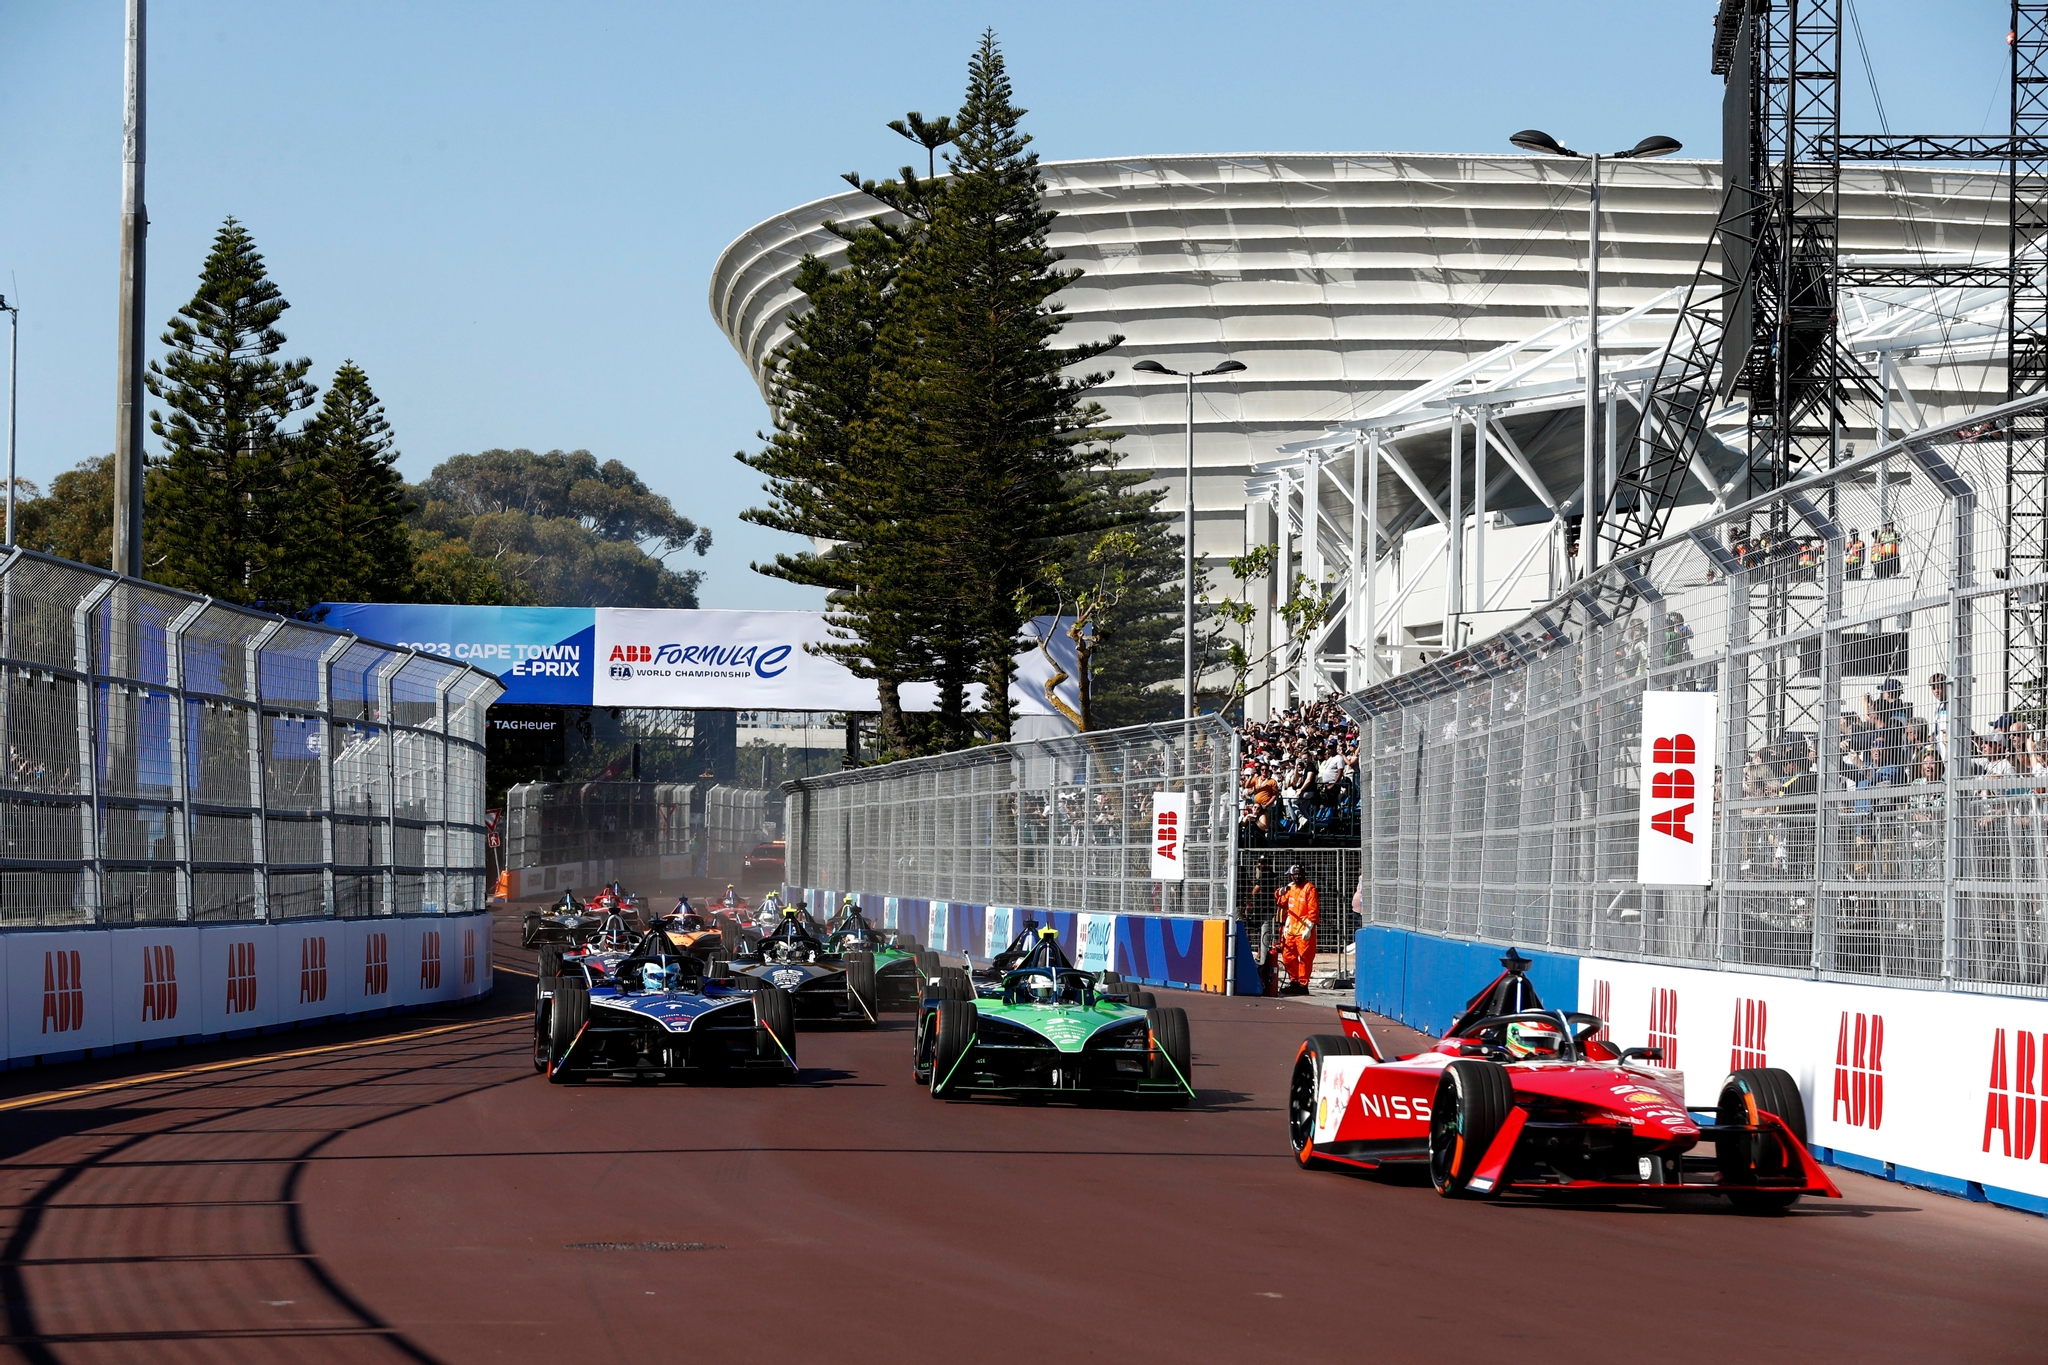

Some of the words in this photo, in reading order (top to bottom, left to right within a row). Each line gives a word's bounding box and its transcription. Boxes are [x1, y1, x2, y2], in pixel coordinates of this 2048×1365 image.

[455, 643, 511, 659] CAPE
[515, 645, 580, 661] TOWN
[512, 661, 580, 677] E-PRIX
[609, 645, 652, 662] ABB
[654, 644, 758, 667] FORMULA
[636, 669, 671, 677] WORLD
[675, 669, 751, 678] CHAMPIONSHIP
[1652, 733, 1695, 844] ABB
[1157, 811, 1177, 860] ABB
[42, 950, 83, 1034] ABB
[142, 945, 178, 1022] ABB
[226, 942, 257, 1014] ABB
[300, 936, 327, 1004] ABB
[365, 933, 388, 996] ABB
[421, 931, 440, 990] ABB
[1647, 987, 1677, 1070] ABB
[1730, 998, 1768, 1074] ABB
[1833, 1011, 1883, 1131] ABB
